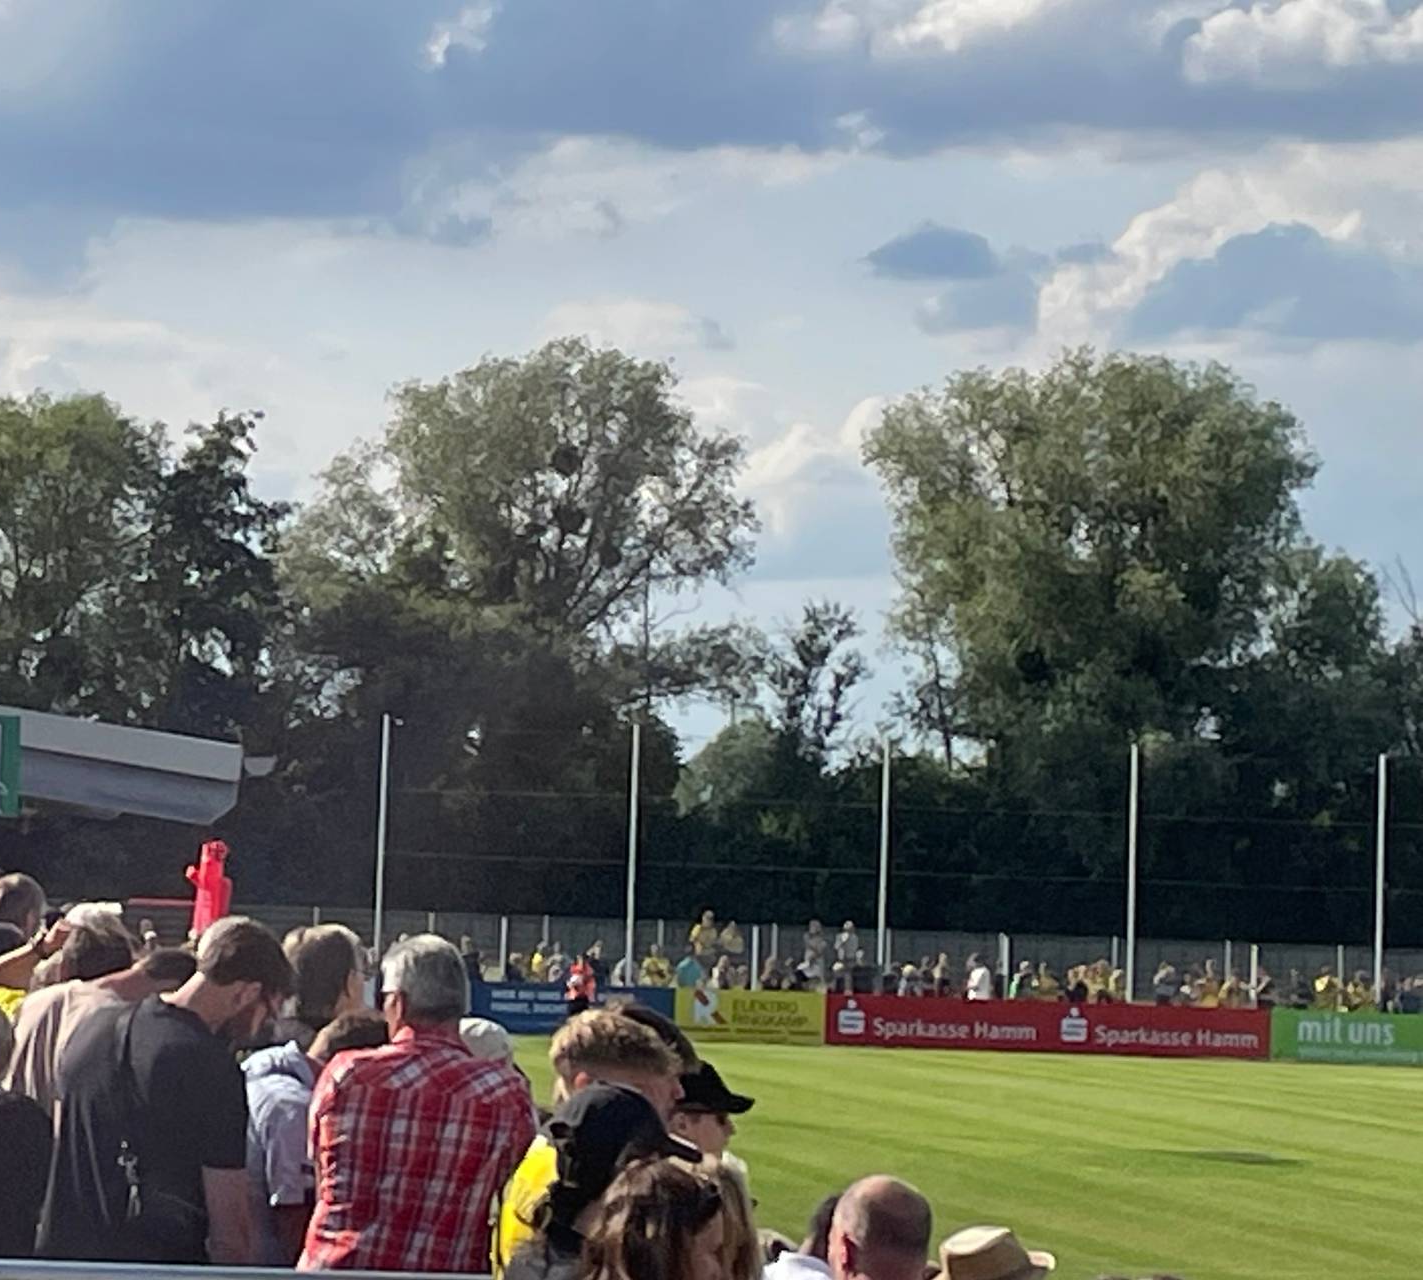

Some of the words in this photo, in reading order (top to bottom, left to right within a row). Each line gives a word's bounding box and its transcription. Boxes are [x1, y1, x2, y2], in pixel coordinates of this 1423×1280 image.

[732, 999, 799, 1014] ELEKTRO
[873, 1017, 970, 1040] Sparkasse
[974, 1021, 1038, 1040] Hamm
[1095, 1025, 1193, 1047] Sparkasse
[1196, 1029, 1259, 1048] Hamm
[1298, 1013, 1343, 1043] mit
[1348, 1022, 1394, 1045] uns
